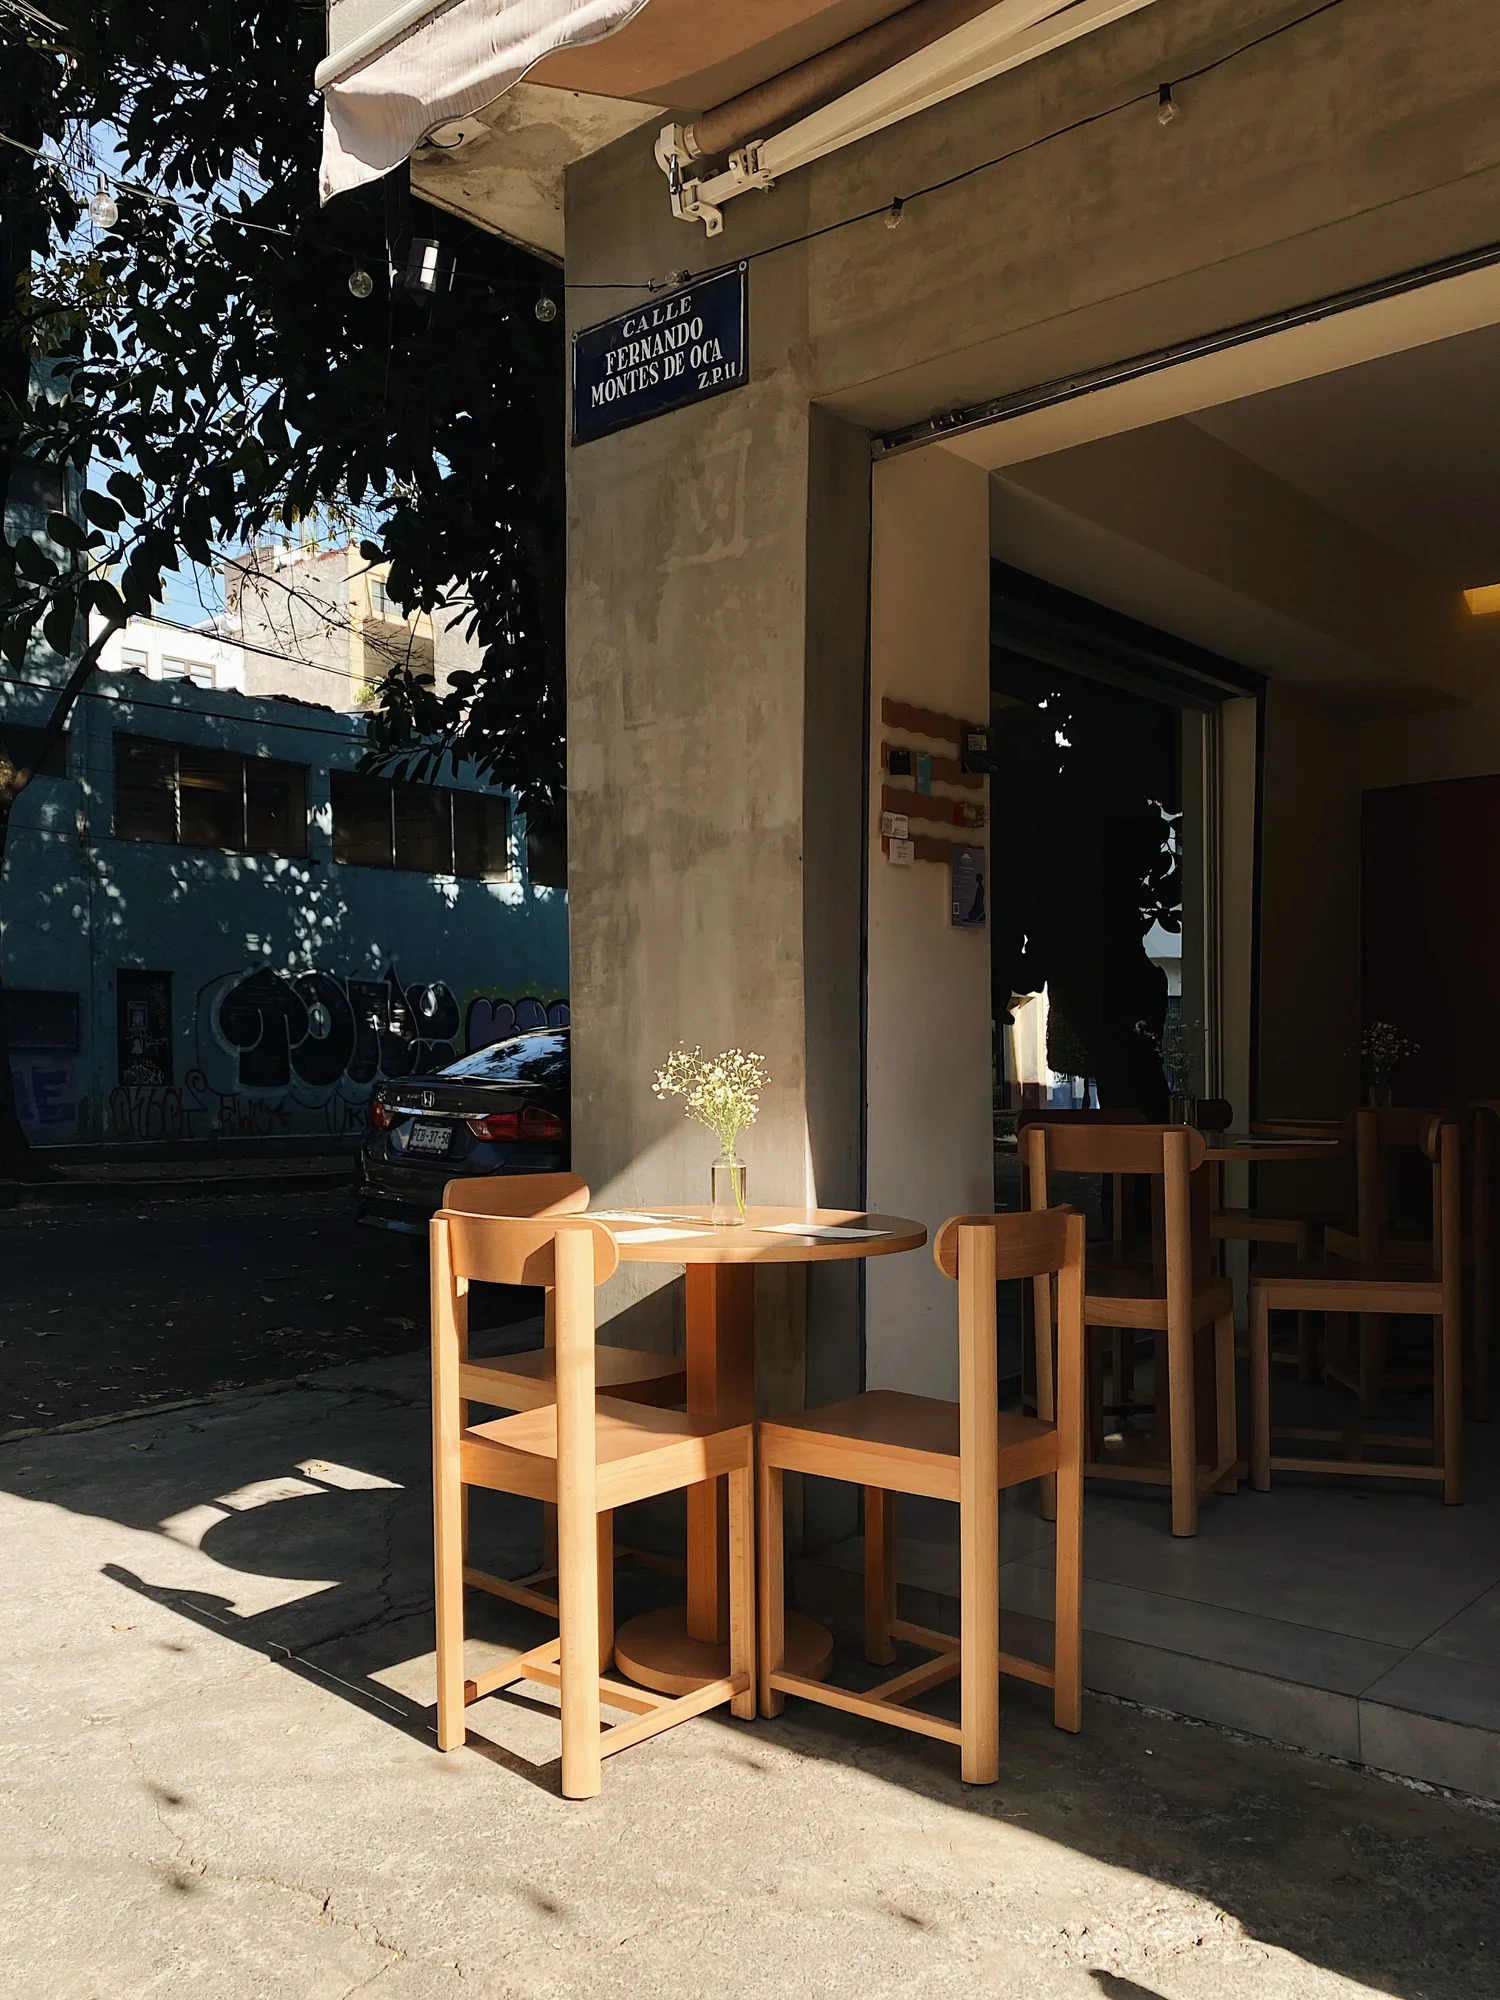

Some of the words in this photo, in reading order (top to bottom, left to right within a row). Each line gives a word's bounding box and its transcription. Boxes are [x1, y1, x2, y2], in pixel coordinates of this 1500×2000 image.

[623, 296, 692, 338] CALLE
[605, 317, 703, 376] FERNANDO
[591, 361, 659, 408] MONTES
[663, 351, 685, 380] DE
[690, 338, 723, 369] OCA
[698, 361, 736, 390] Z.P.11
